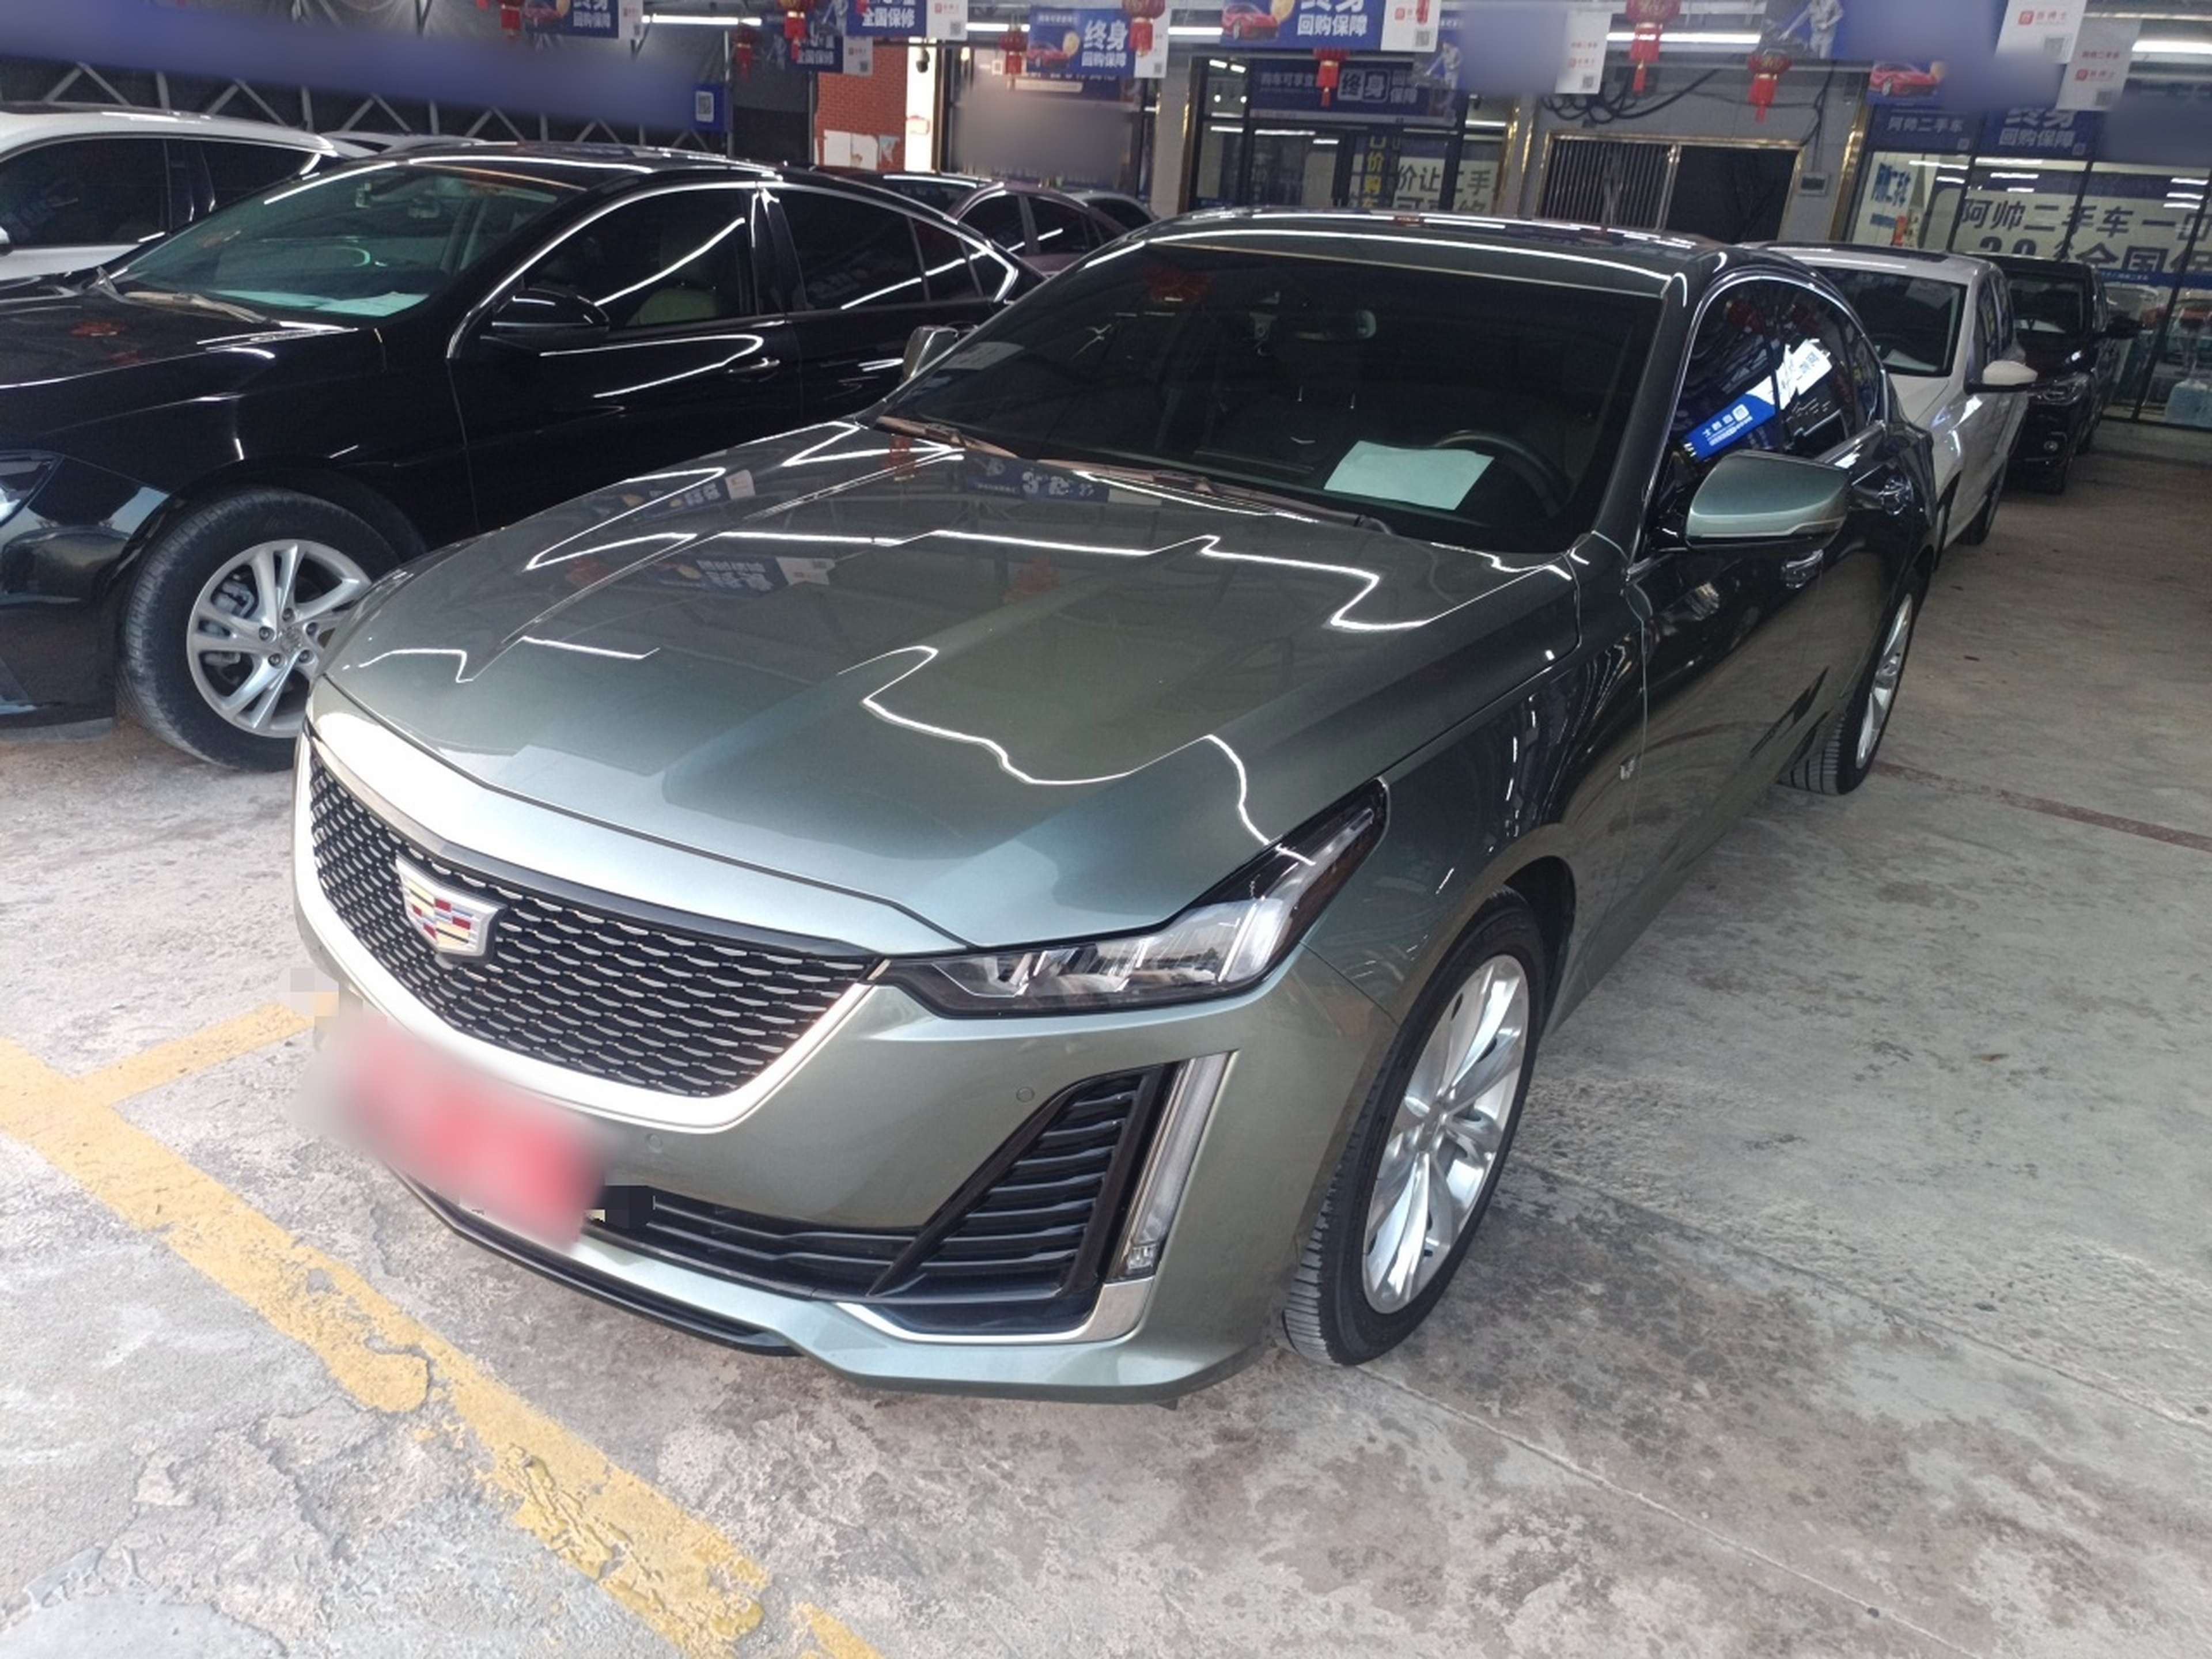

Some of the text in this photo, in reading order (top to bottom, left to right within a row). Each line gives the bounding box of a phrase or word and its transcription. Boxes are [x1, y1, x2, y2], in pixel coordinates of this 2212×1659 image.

[862, 7, 915, 28] 全国保修
[1297, 14, 1368, 36] 回购保障
[1084, 20, 1127, 50] 终身
[1081, 51, 1127, 67] 回购保障
[1888, 116, 1964, 133] 阿帅二手车
[1999, 127, 2075, 147] 回购保障
